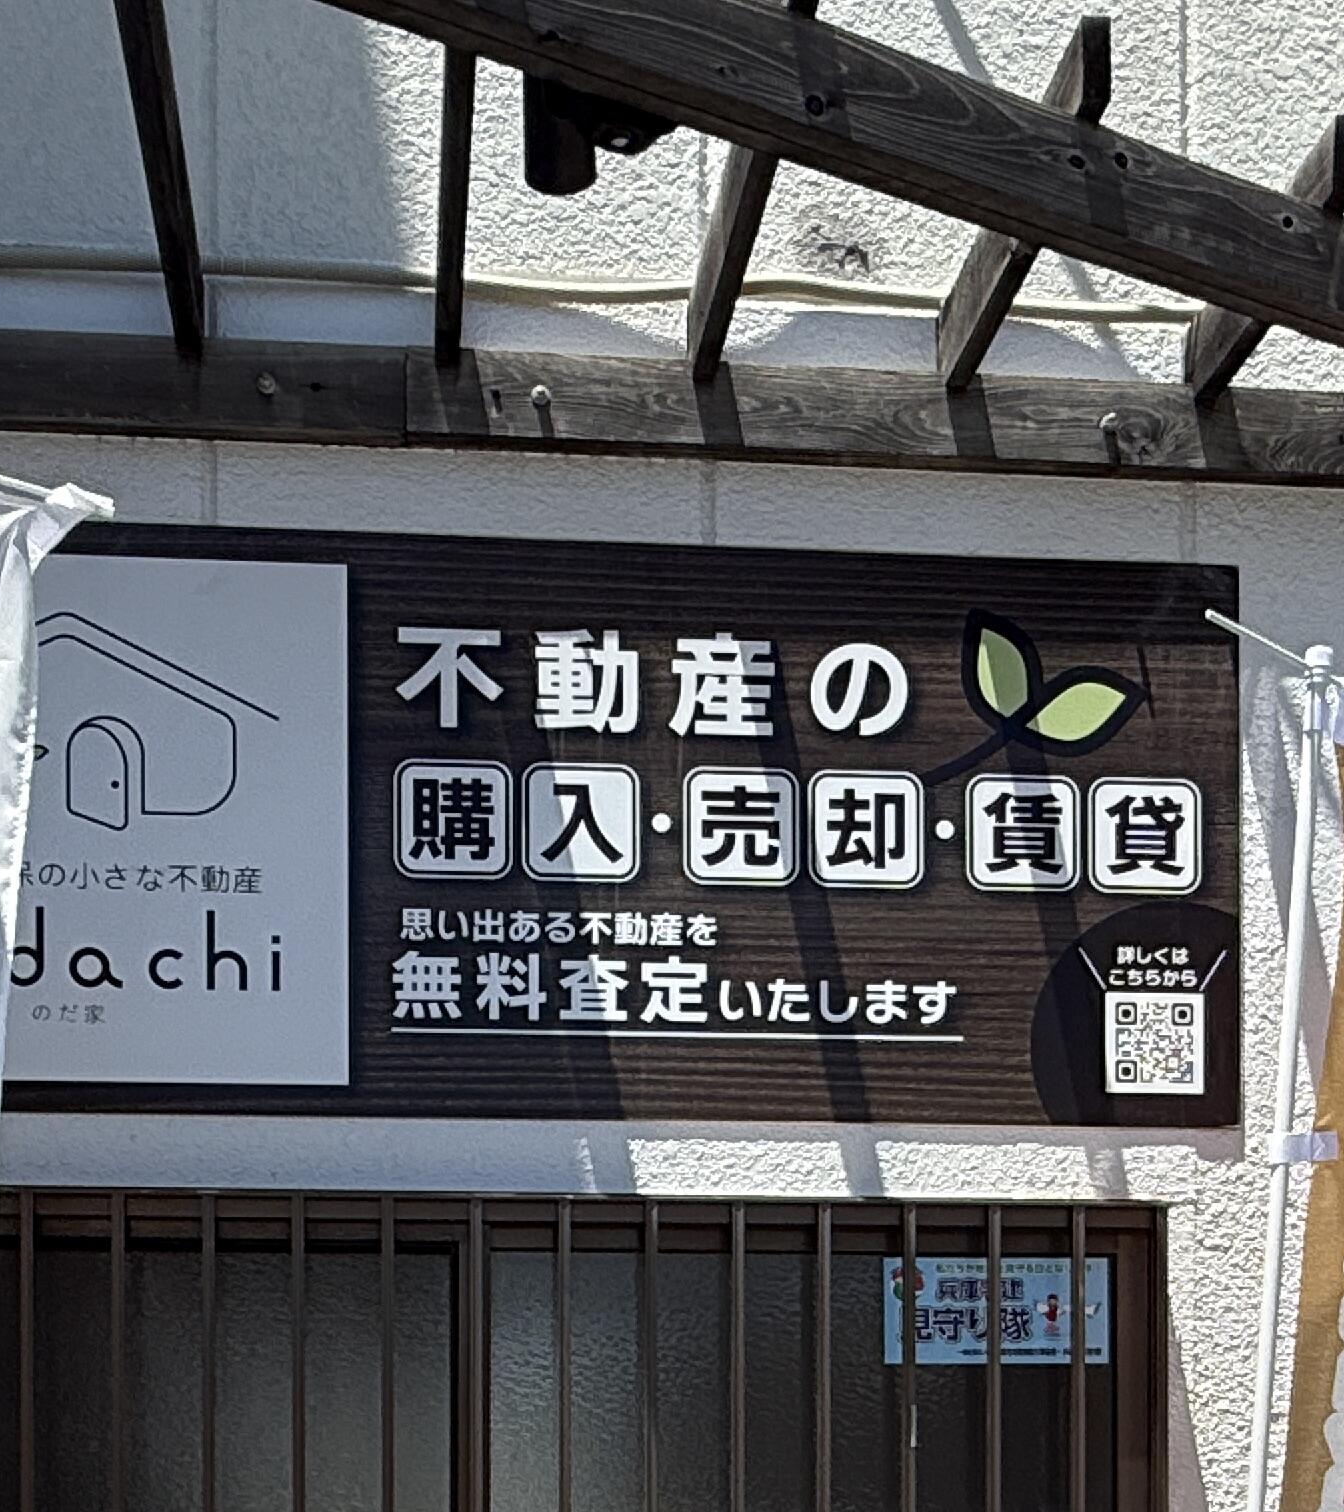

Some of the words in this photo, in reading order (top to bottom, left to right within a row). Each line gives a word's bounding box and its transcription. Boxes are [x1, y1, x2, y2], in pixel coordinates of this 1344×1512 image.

[394, 625, 910, 738] 不動産の
[400, 907, 718, 947] 思い出ある不動産を
[1116, 944, 1190, 966] 詳しくは
[390, 950, 958, 1025] 無料査定いたします
[1108, 968, 1198, 988] こちらから
[32, 1004, 107, 1025] のだ家
